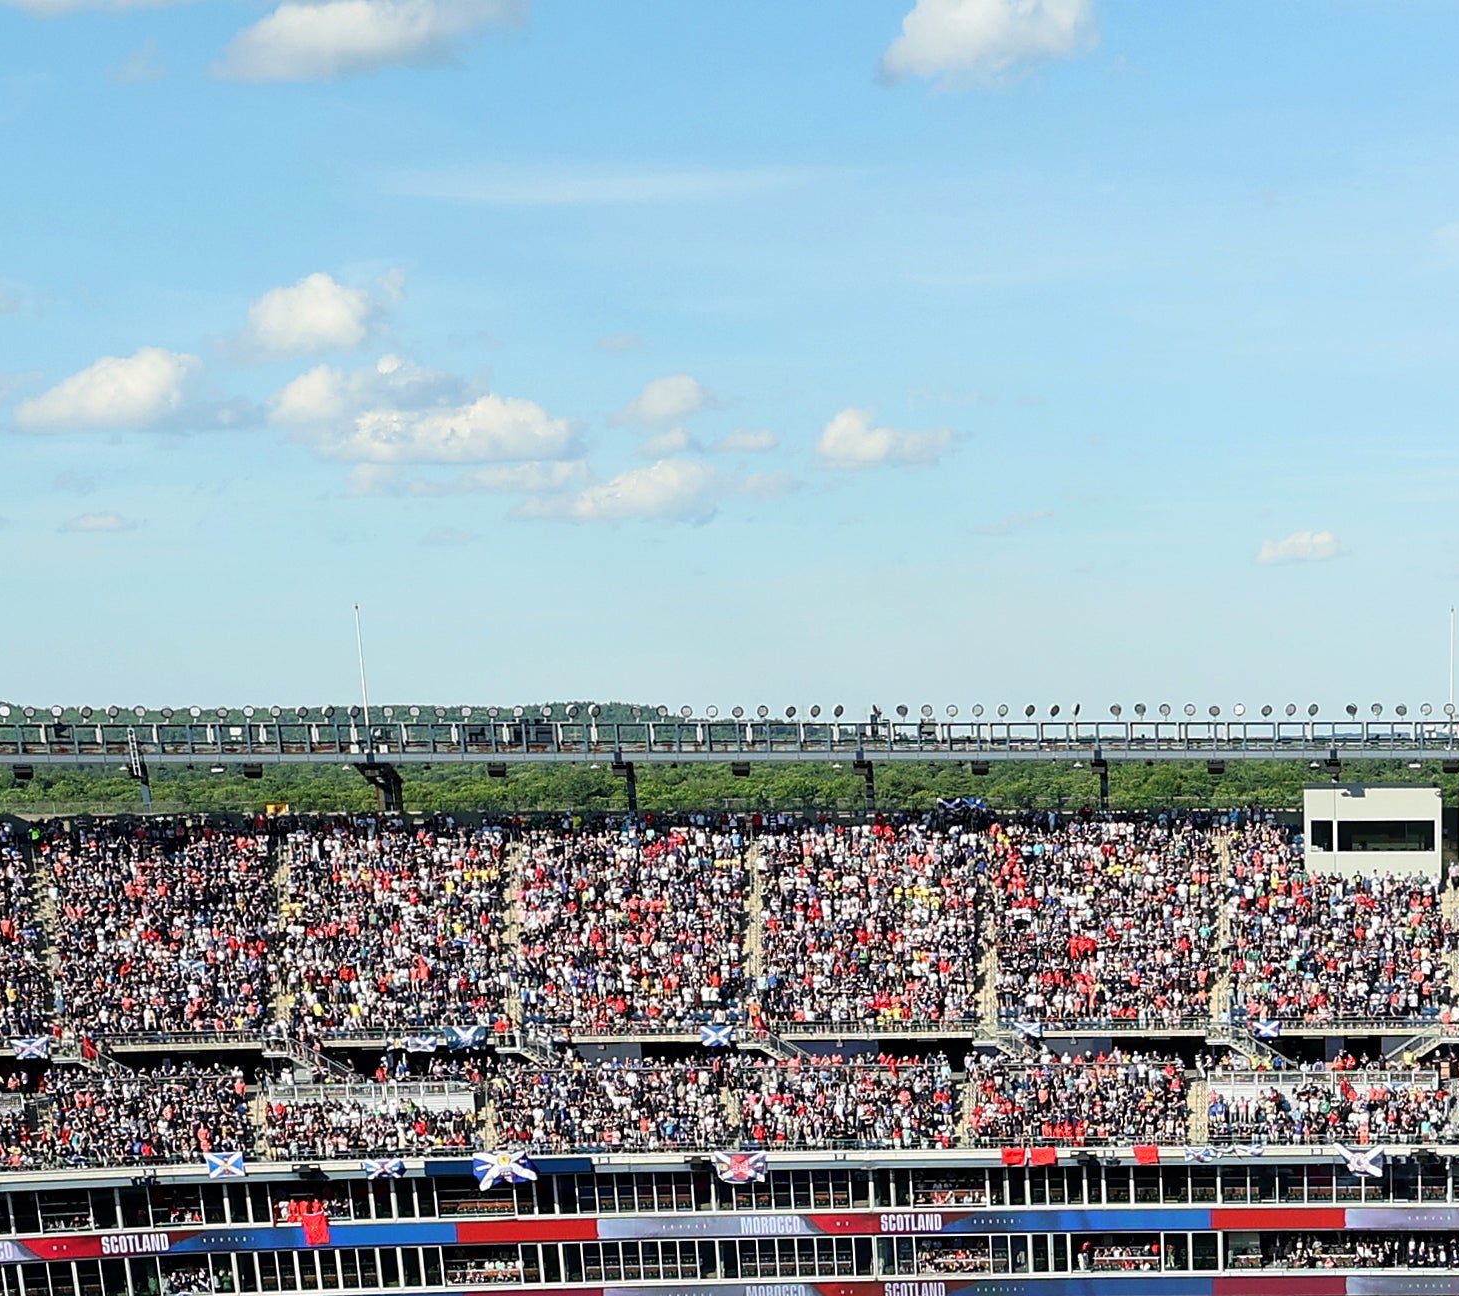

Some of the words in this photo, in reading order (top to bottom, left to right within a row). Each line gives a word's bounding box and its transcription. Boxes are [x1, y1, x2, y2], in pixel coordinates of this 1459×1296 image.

[740, 1215, 801, 1235] MOROCCO
[880, 1213, 943, 1232] SCOTLAND
[100, 1233, 171, 1255] SCOTLAND
